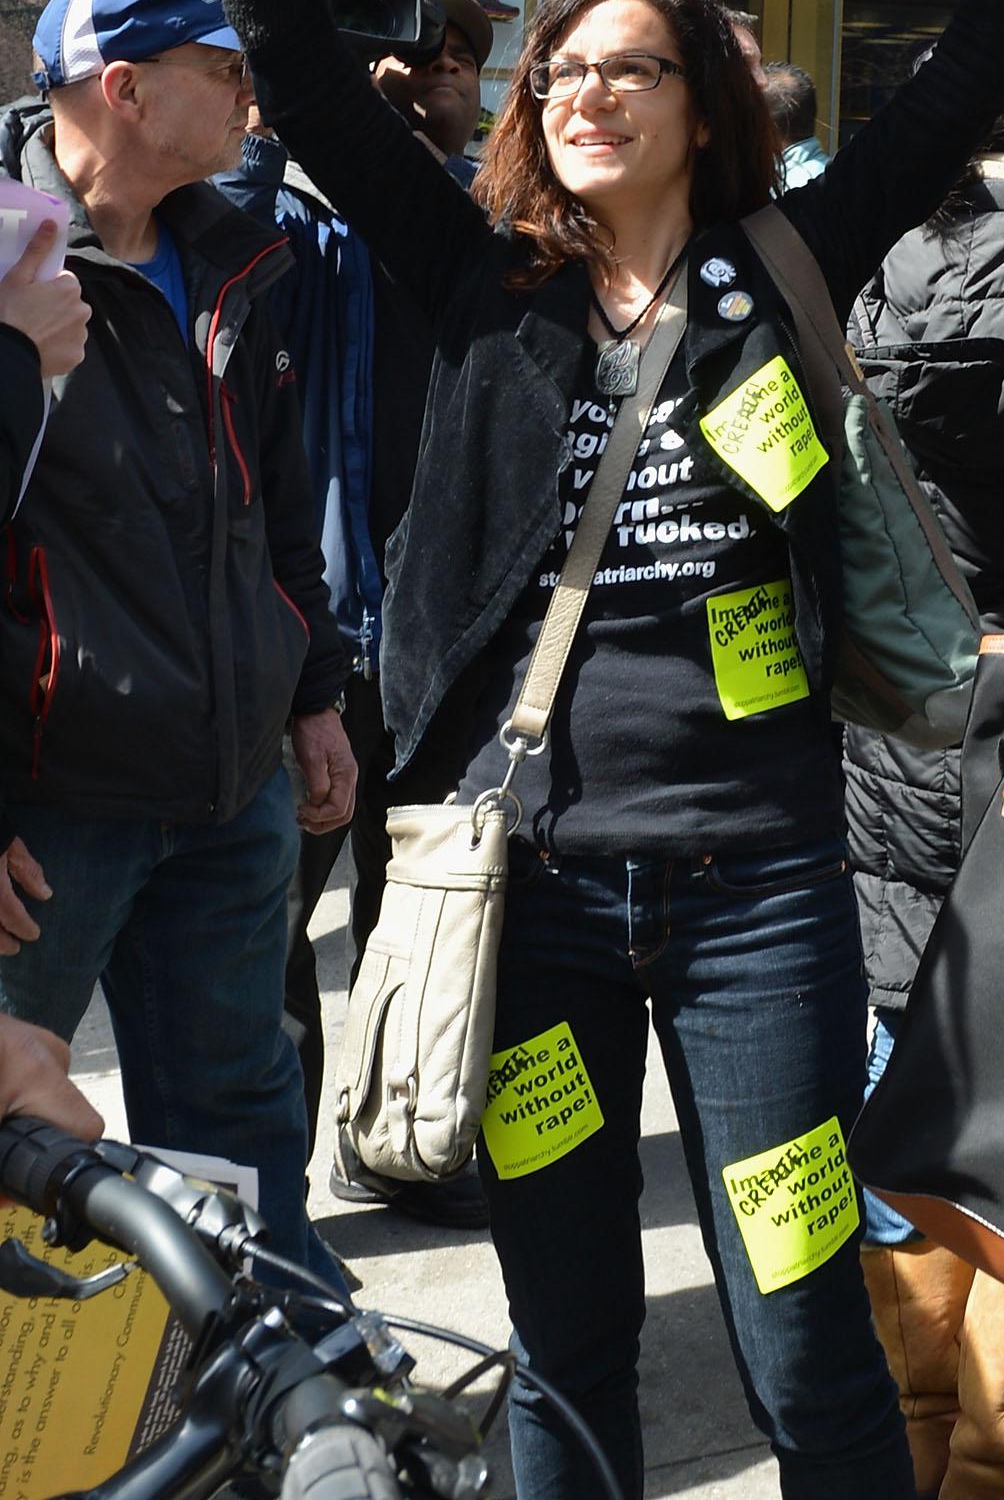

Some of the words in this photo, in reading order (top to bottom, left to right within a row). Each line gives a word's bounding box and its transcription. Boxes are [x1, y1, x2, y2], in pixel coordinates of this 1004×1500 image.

[780, 370, 791, 383] a
[759, 384, 800, 424] world
[757, 404, 809, 453] without
[789, 422, 816, 457] rape!
[538, 561, 716, 588] stoatriarchy.org
[738, 632, 799, 662] without
[766, 651, 802, 677] rape!
[556, 1037, 571, 1052] a
[513, 1052, 578, 1097] world
[500, 1072, 586, 1125] without
[535, 1089, 592, 1136] rape!
[828, 1132, 840, 1148] a
[787, 1149, 845, 1196] world
[771, 1169, 850, 1227] without
[807, 1187, 853, 1236] rape!
[61, 1319, 77, 1341] all
[55, 1346, 69, 1362] to
[11, 1419, 24, 1440] as
[18, 1396, 31, 1413] to
[25, 1352, 46, 1390] why
[39, 1312, 56, 1349] and
[36, 1369, 61, 1432] answer
[83, 1351, 126, 1457] Revolutionary
[21, 1438, 41, 1464] the
[17, 1470, 32, 1484] is
